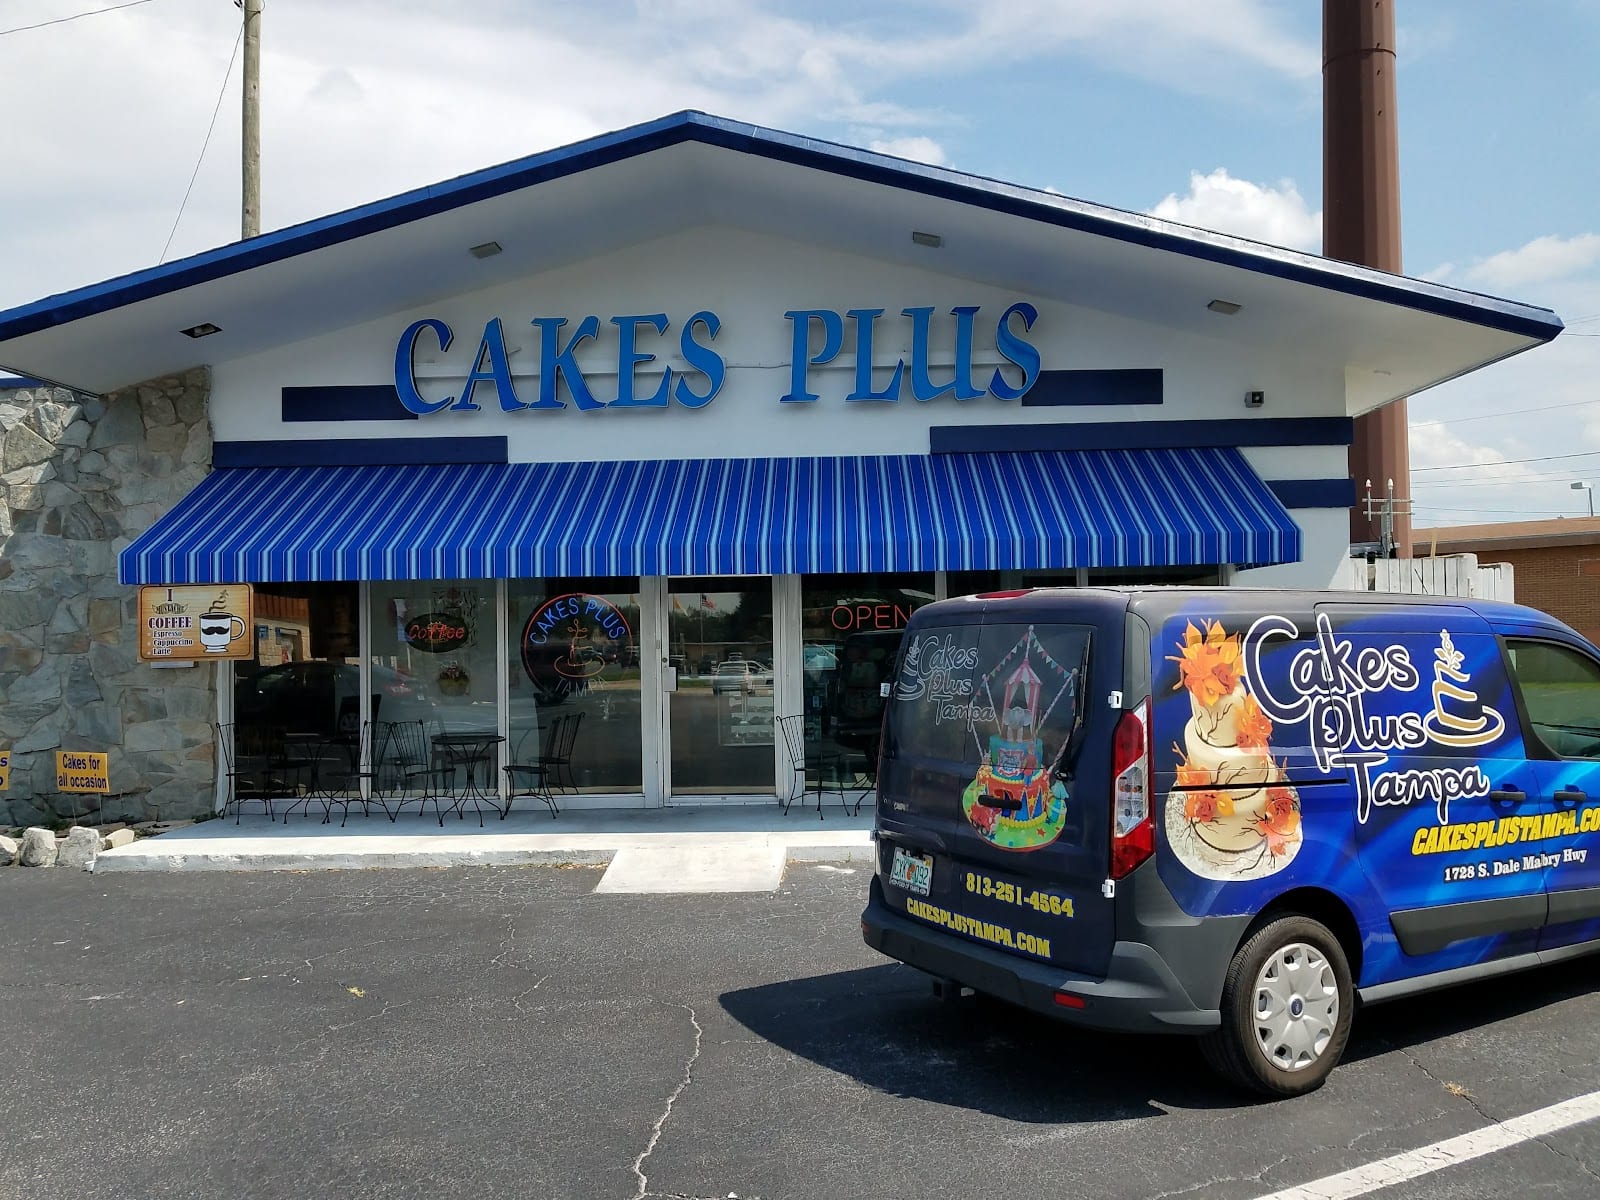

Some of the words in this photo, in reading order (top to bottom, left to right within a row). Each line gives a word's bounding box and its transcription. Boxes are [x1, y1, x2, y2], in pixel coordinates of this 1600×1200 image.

[394, 311, 727, 415] CAKES
[779, 302, 1041, 403] PLUS
[167, 588, 173, 602] I
[148, 616, 192, 629] COFFEE
[408, 624, 465, 640] Coffee
[530, 597, 579, 644] CAKES
[585, 599, 626, 639] PLUS
[831, 604, 912, 630] OPEN
[153, 630, 183, 640] Espresso
[153, 638, 193, 648] Cappuccino
[153, 647, 171, 655] Latte
[917, 633, 979, 681] Cakes
[1242, 612, 1419, 724] Cakes
[930, 694, 997, 733] Tampa
[62, 753, 87, 769] Cakes
[89, 755, 101, 769] for
[58, 772, 68, 787] all
[70, 774, 107, 789] occasion
[1329, 751, 1491, 825] Tampa
[1411, 806, 1600, 856] CAKESPLUSTAMPA.CO
[1444, 866, 1475, 882] 1728
[1478, 863, 1490, 878] S.
[1493, 859, 1520, 876] Dale
[1522, 852, 1561, 871] Mabry
[1563, 847, 1587, 864] Hwy
[966, 872, 1074, 918] 813-251-4564
[906, 897, 1051, 958] CAKESPLUSTAMPA.COM
